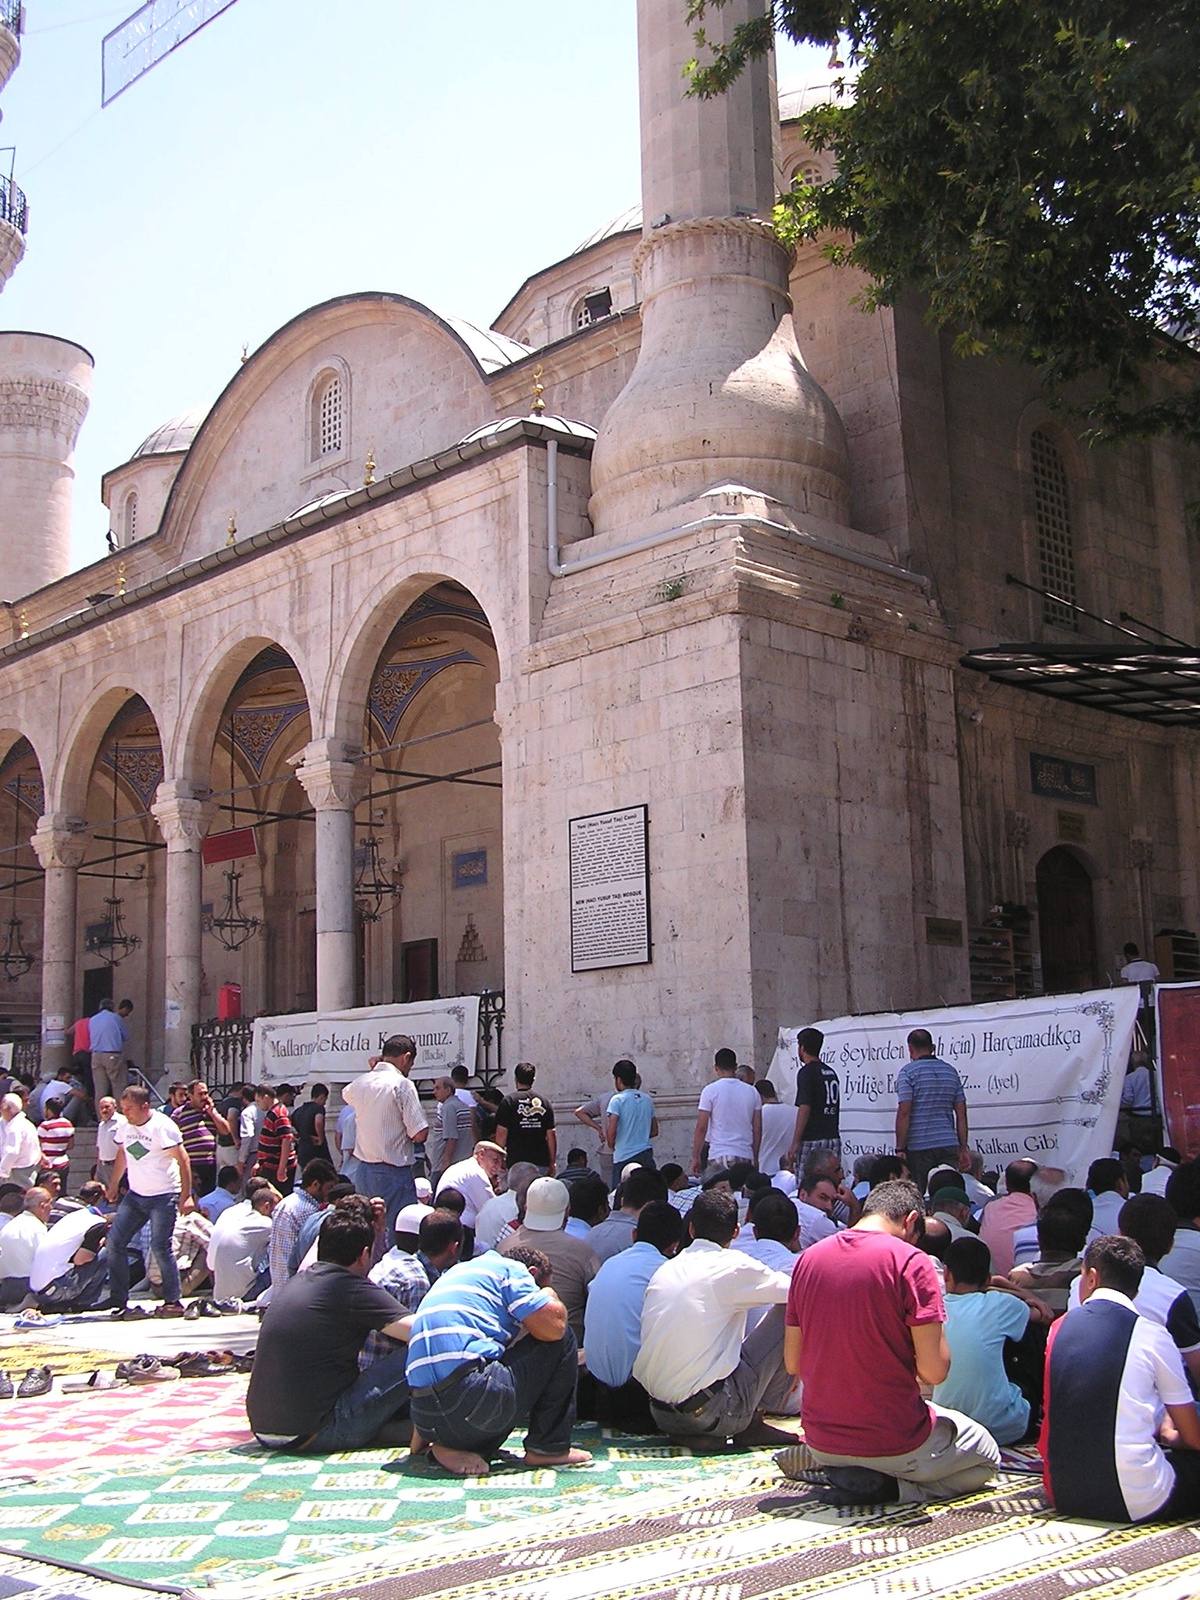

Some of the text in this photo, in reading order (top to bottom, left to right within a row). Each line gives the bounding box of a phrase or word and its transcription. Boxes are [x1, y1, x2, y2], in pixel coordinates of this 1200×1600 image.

[840, 1040, 905, 1068] Şeylerden
[949, 1033, 976, 1061] için)
[982, 1023, 1081, 1056] Harçamadıkça
[824, 1079, 839, 1105] 10
[844, 1070, 884, 1103] İyiliğe
[987, 1072, 1020, 1095] (Ayet)
[975, 1137, 1019, 1155] Kalkan
[1024, 1133, 1059, 1152] Gibi
